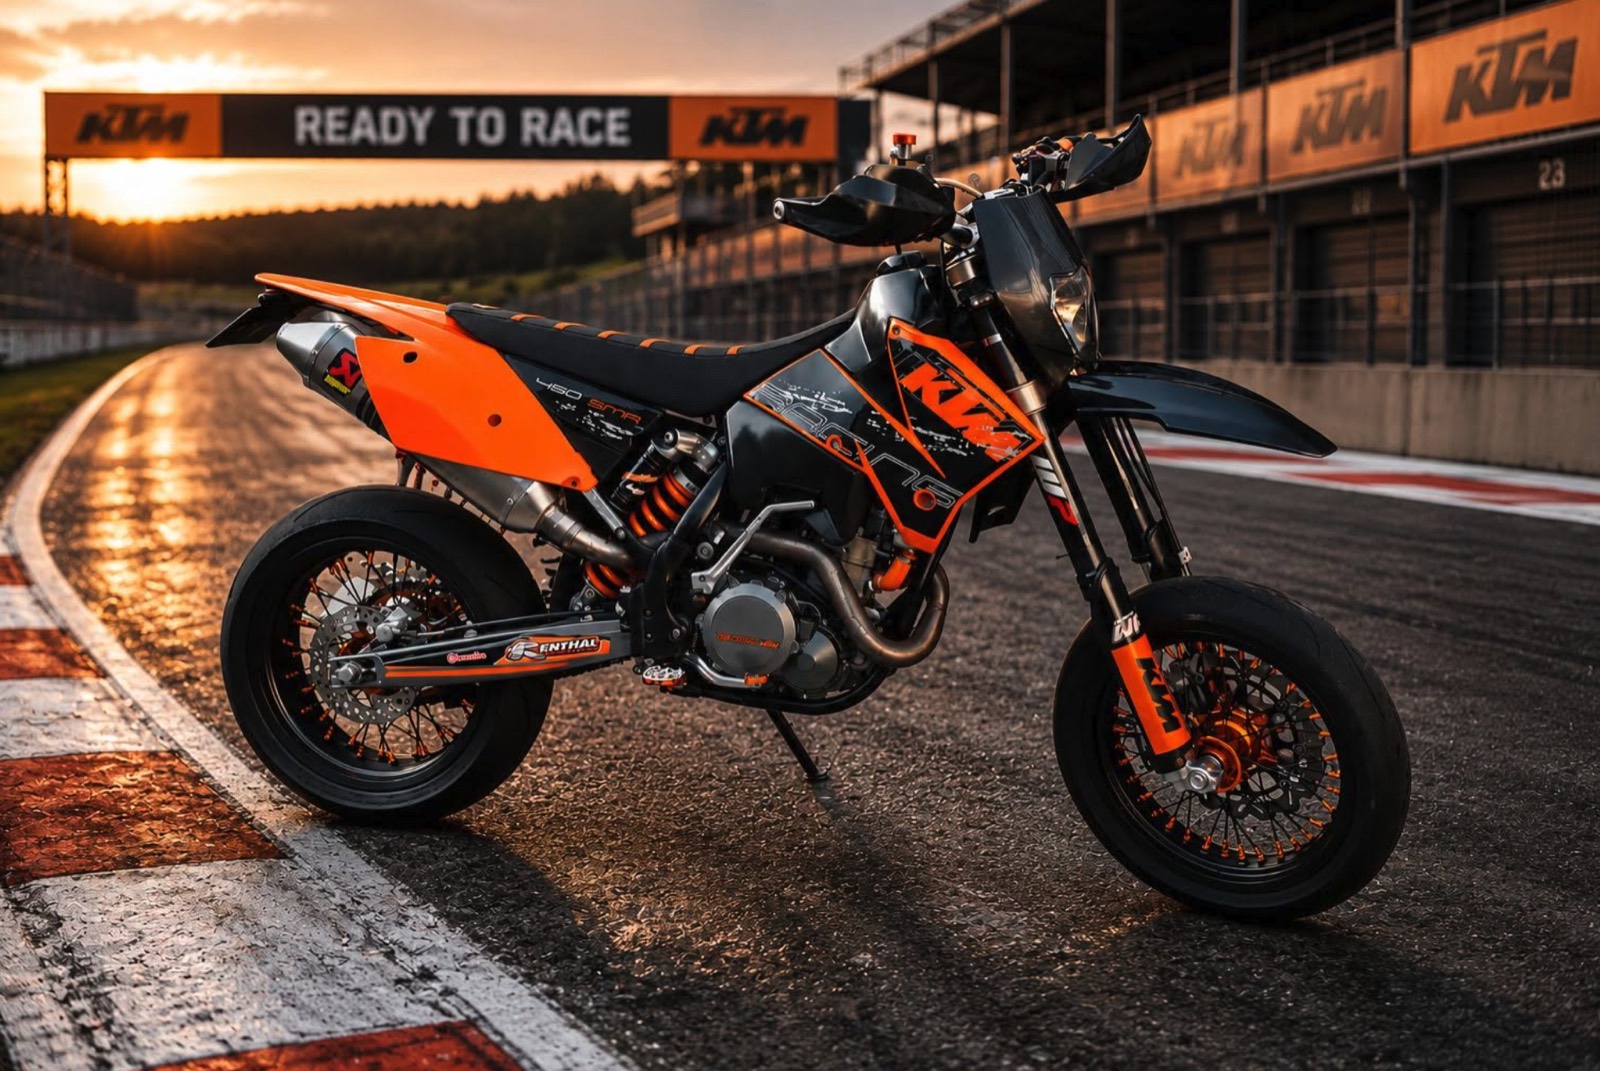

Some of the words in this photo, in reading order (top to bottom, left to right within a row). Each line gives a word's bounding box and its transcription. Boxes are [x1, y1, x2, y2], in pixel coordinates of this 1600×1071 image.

[1443, 29, 1578, 123] KTM
[77, 104, 189, 143] KTM
[295, 106, 434, 145] READY
[449, 107, 506, 146] TO
[521, 107, 631, 146] RACE
[700, 107, 808, 146] KTM
[1291, 79, 1386, 153] KTM
[536, 377, 582, 400] 450
[509, 638, 598, 660] RENTHAL
